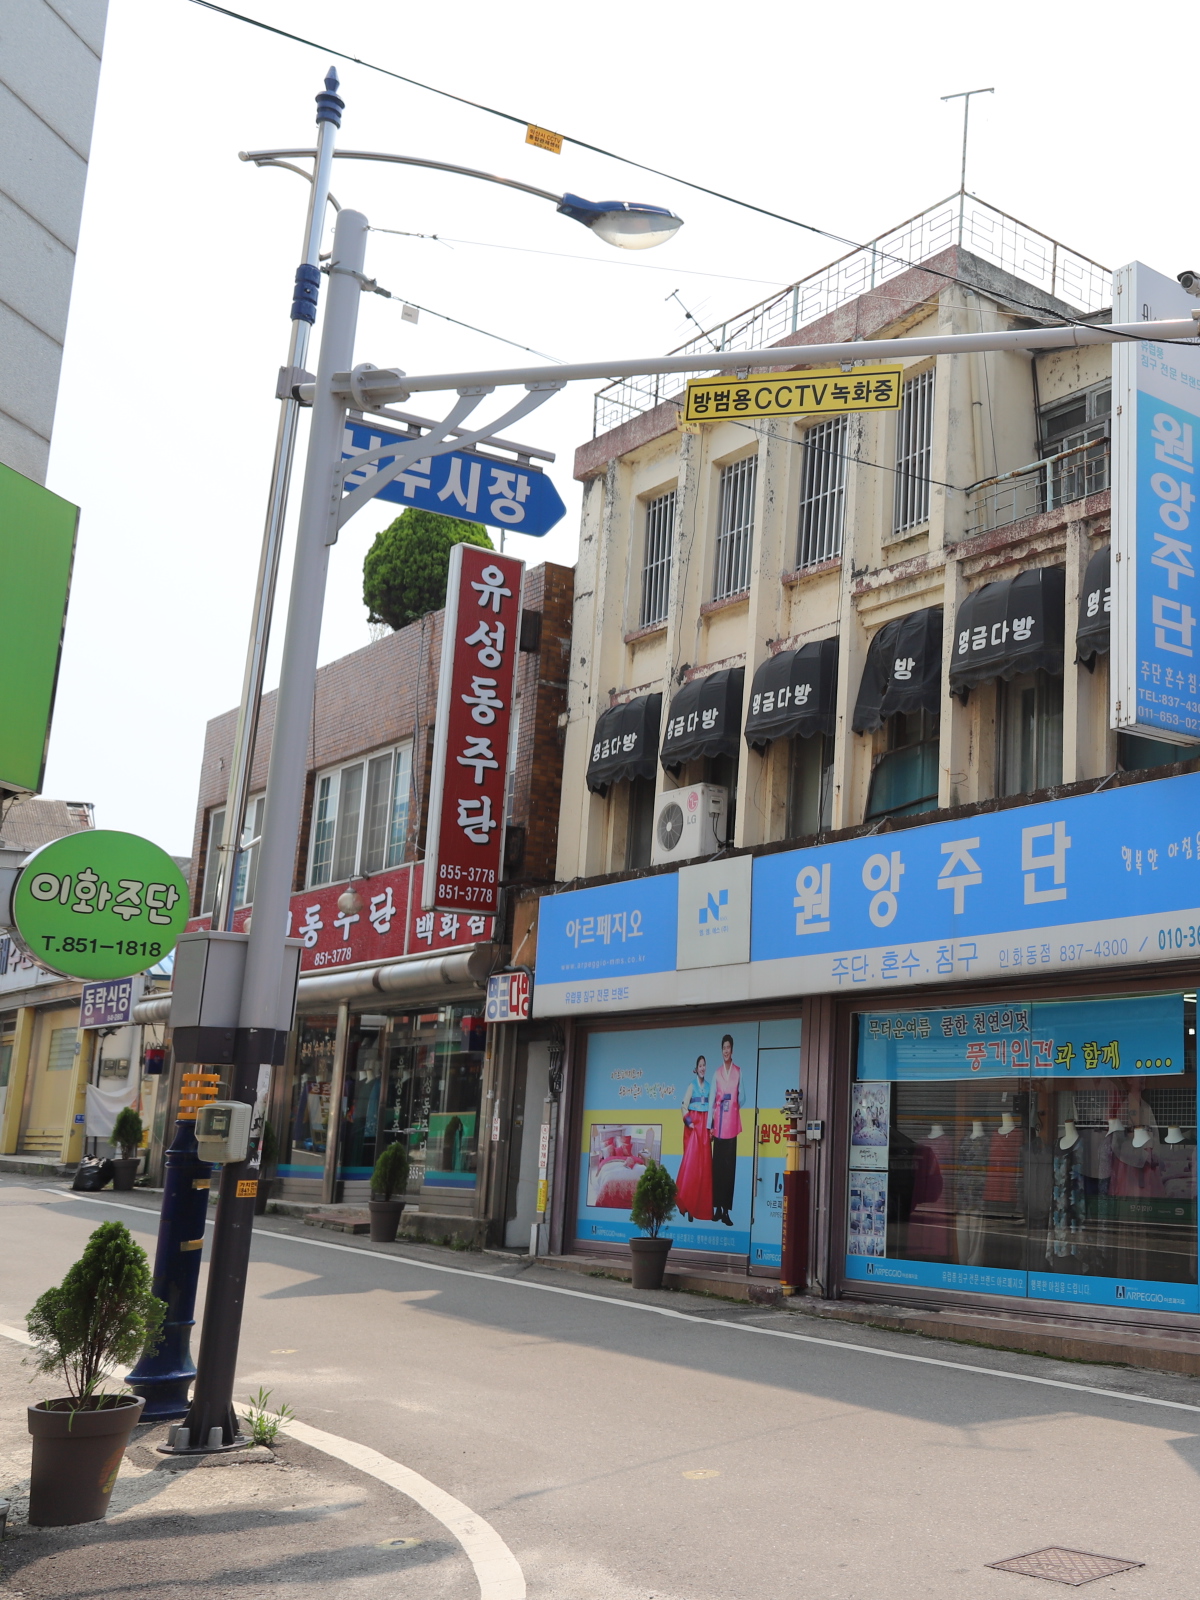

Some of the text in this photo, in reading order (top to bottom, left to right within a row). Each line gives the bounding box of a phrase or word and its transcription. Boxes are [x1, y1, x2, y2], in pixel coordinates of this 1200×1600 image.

[1141, 355, 1157, 371] 침구
[1160, 362, 1178, 381] 전문
[1151, 412, 1197, 658] 원양주단
[958, 615, 1036, 655] 명금다방
[894, 657, 916, 680] 방
[1140, 660, 1162, 685] 주단
[1165, 666, 1185, 691] 혼수
[456, 564, 512, 845] 유성동주단
[752, 683, 812, 716] 명금다방
[592, 732, 638, 762] 명금다방
[686, 814, 697, 825] LG
[439, 864, 496, 884] 855-3778
[1121, 845, 1159, 876] 행복한
[793, 820, 1072, 936] 원양주단
[30, 866, 180, 926] 이화주단
[438, 884, 493, 904] 851-3778
[566, 908, 644, 949] 아르페지오
[41, 935, 162, 958] T.851-1818
[314, 946, 352, 967] 851-3778
[999, 942, 1052, 969] 인화동점
[1059, 936, 1128, 963] 837-4300
[84, 983, 132, 1016] 동락식당
[565, 986, 629, 1005] 유럽풍 침구 전문 브랜드
[868, 1009, 1030, 1041] 무더운여름 쿨한 천연의멋
[966, 1038, 1076, 1072] 풍기인견과
[1082, 1040, 1121, 1071] 함께
[1031, 1279, 1048, 1292] 행복한
[1126, 1291, 1164, 1303] ARPEGGIO
